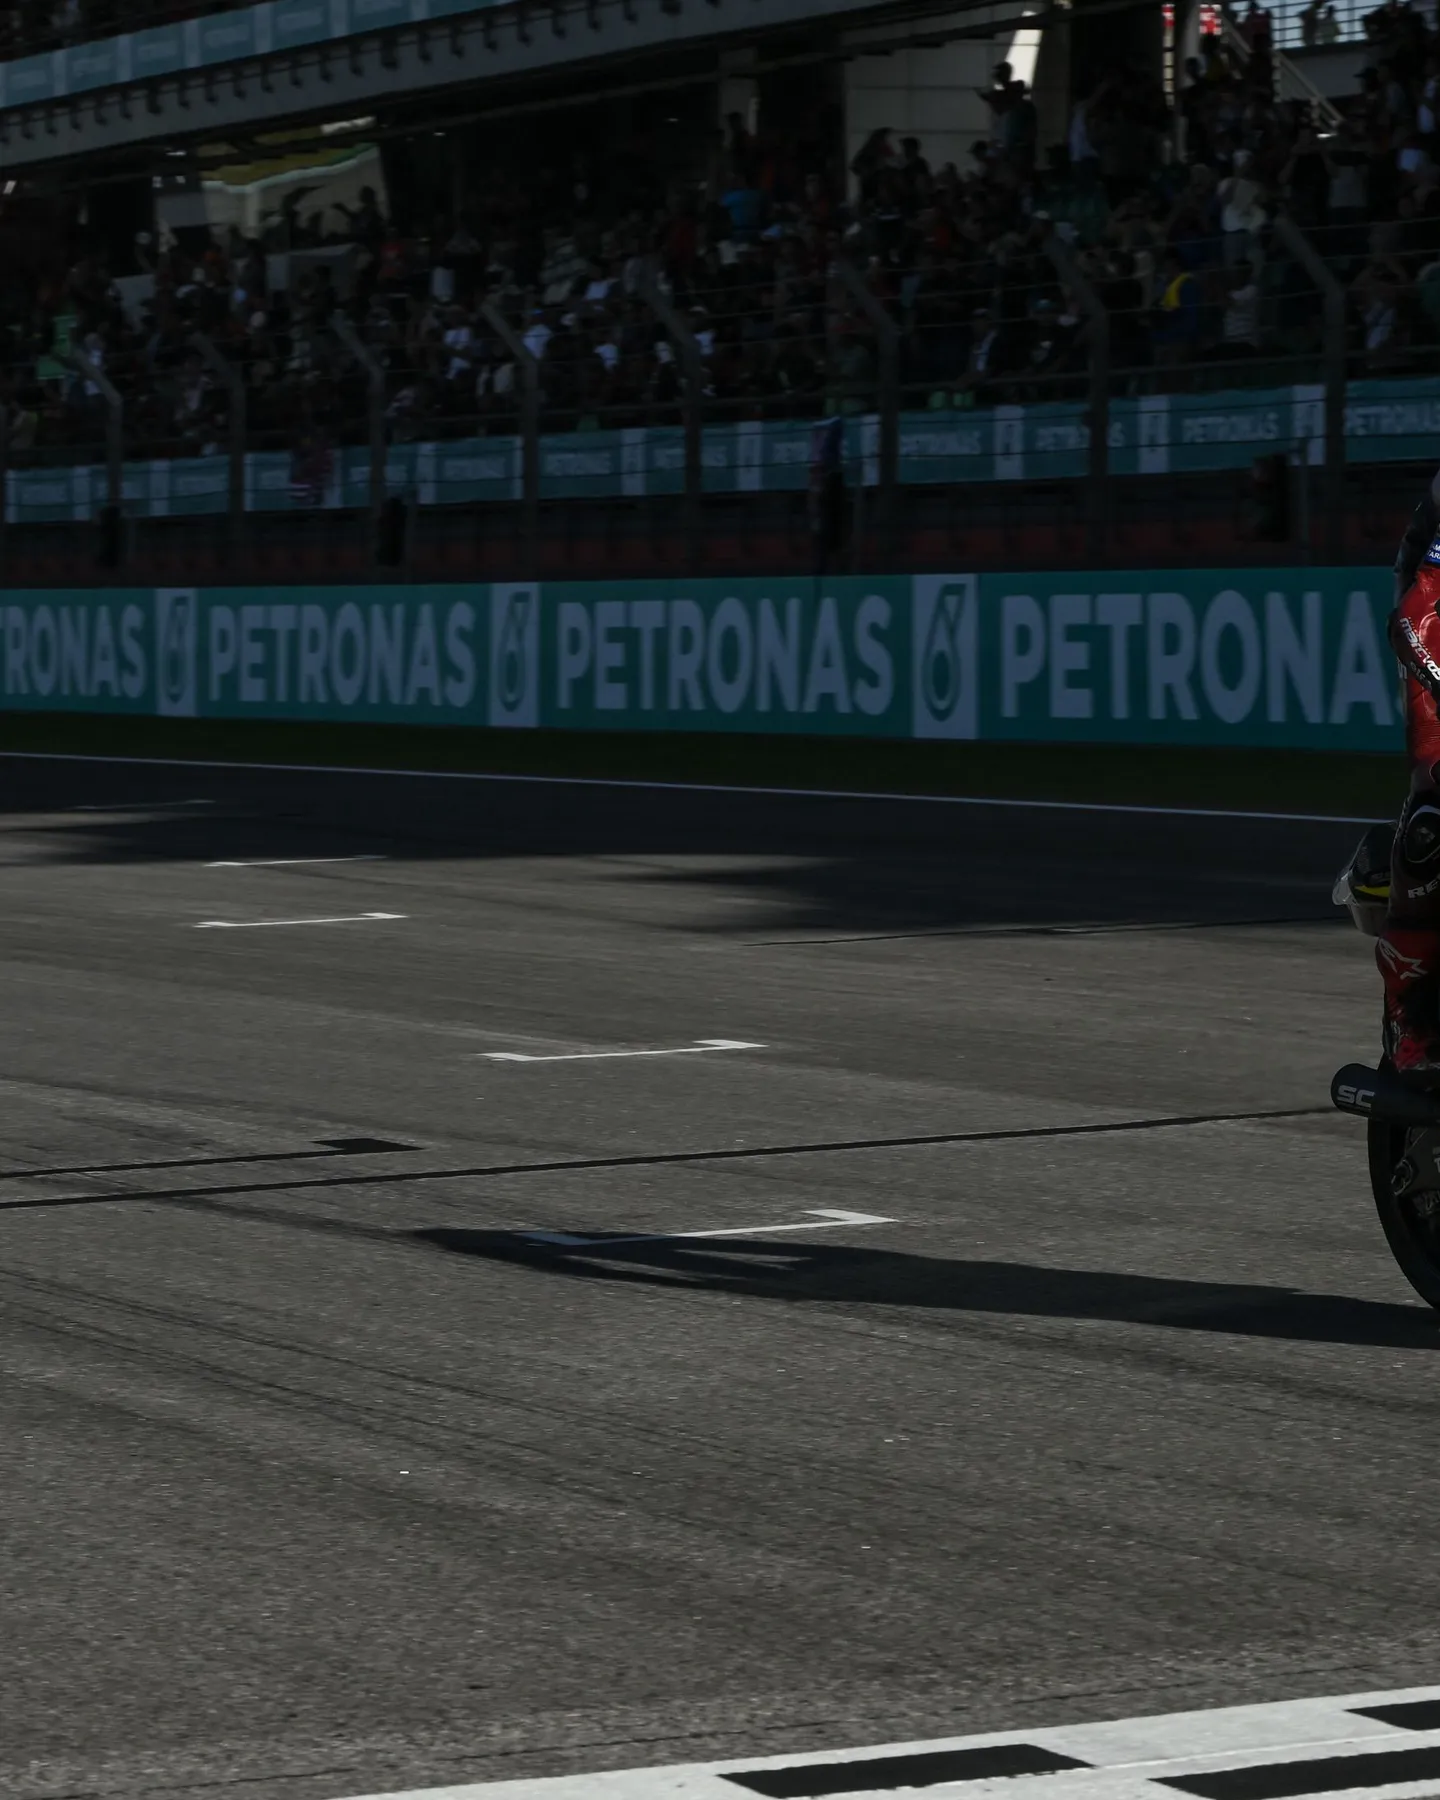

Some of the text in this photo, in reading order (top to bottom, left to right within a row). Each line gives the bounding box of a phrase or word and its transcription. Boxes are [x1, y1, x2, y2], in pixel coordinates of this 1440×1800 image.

[0, 604, 148, 700] RONAS
[208, 600, 478, 708] PETRONAS
[556, 594, 894, 716] PETRONAS
[1000, 588, 1405, 726] PETRONA
[1336, 1084, 1376, 1109] SC
